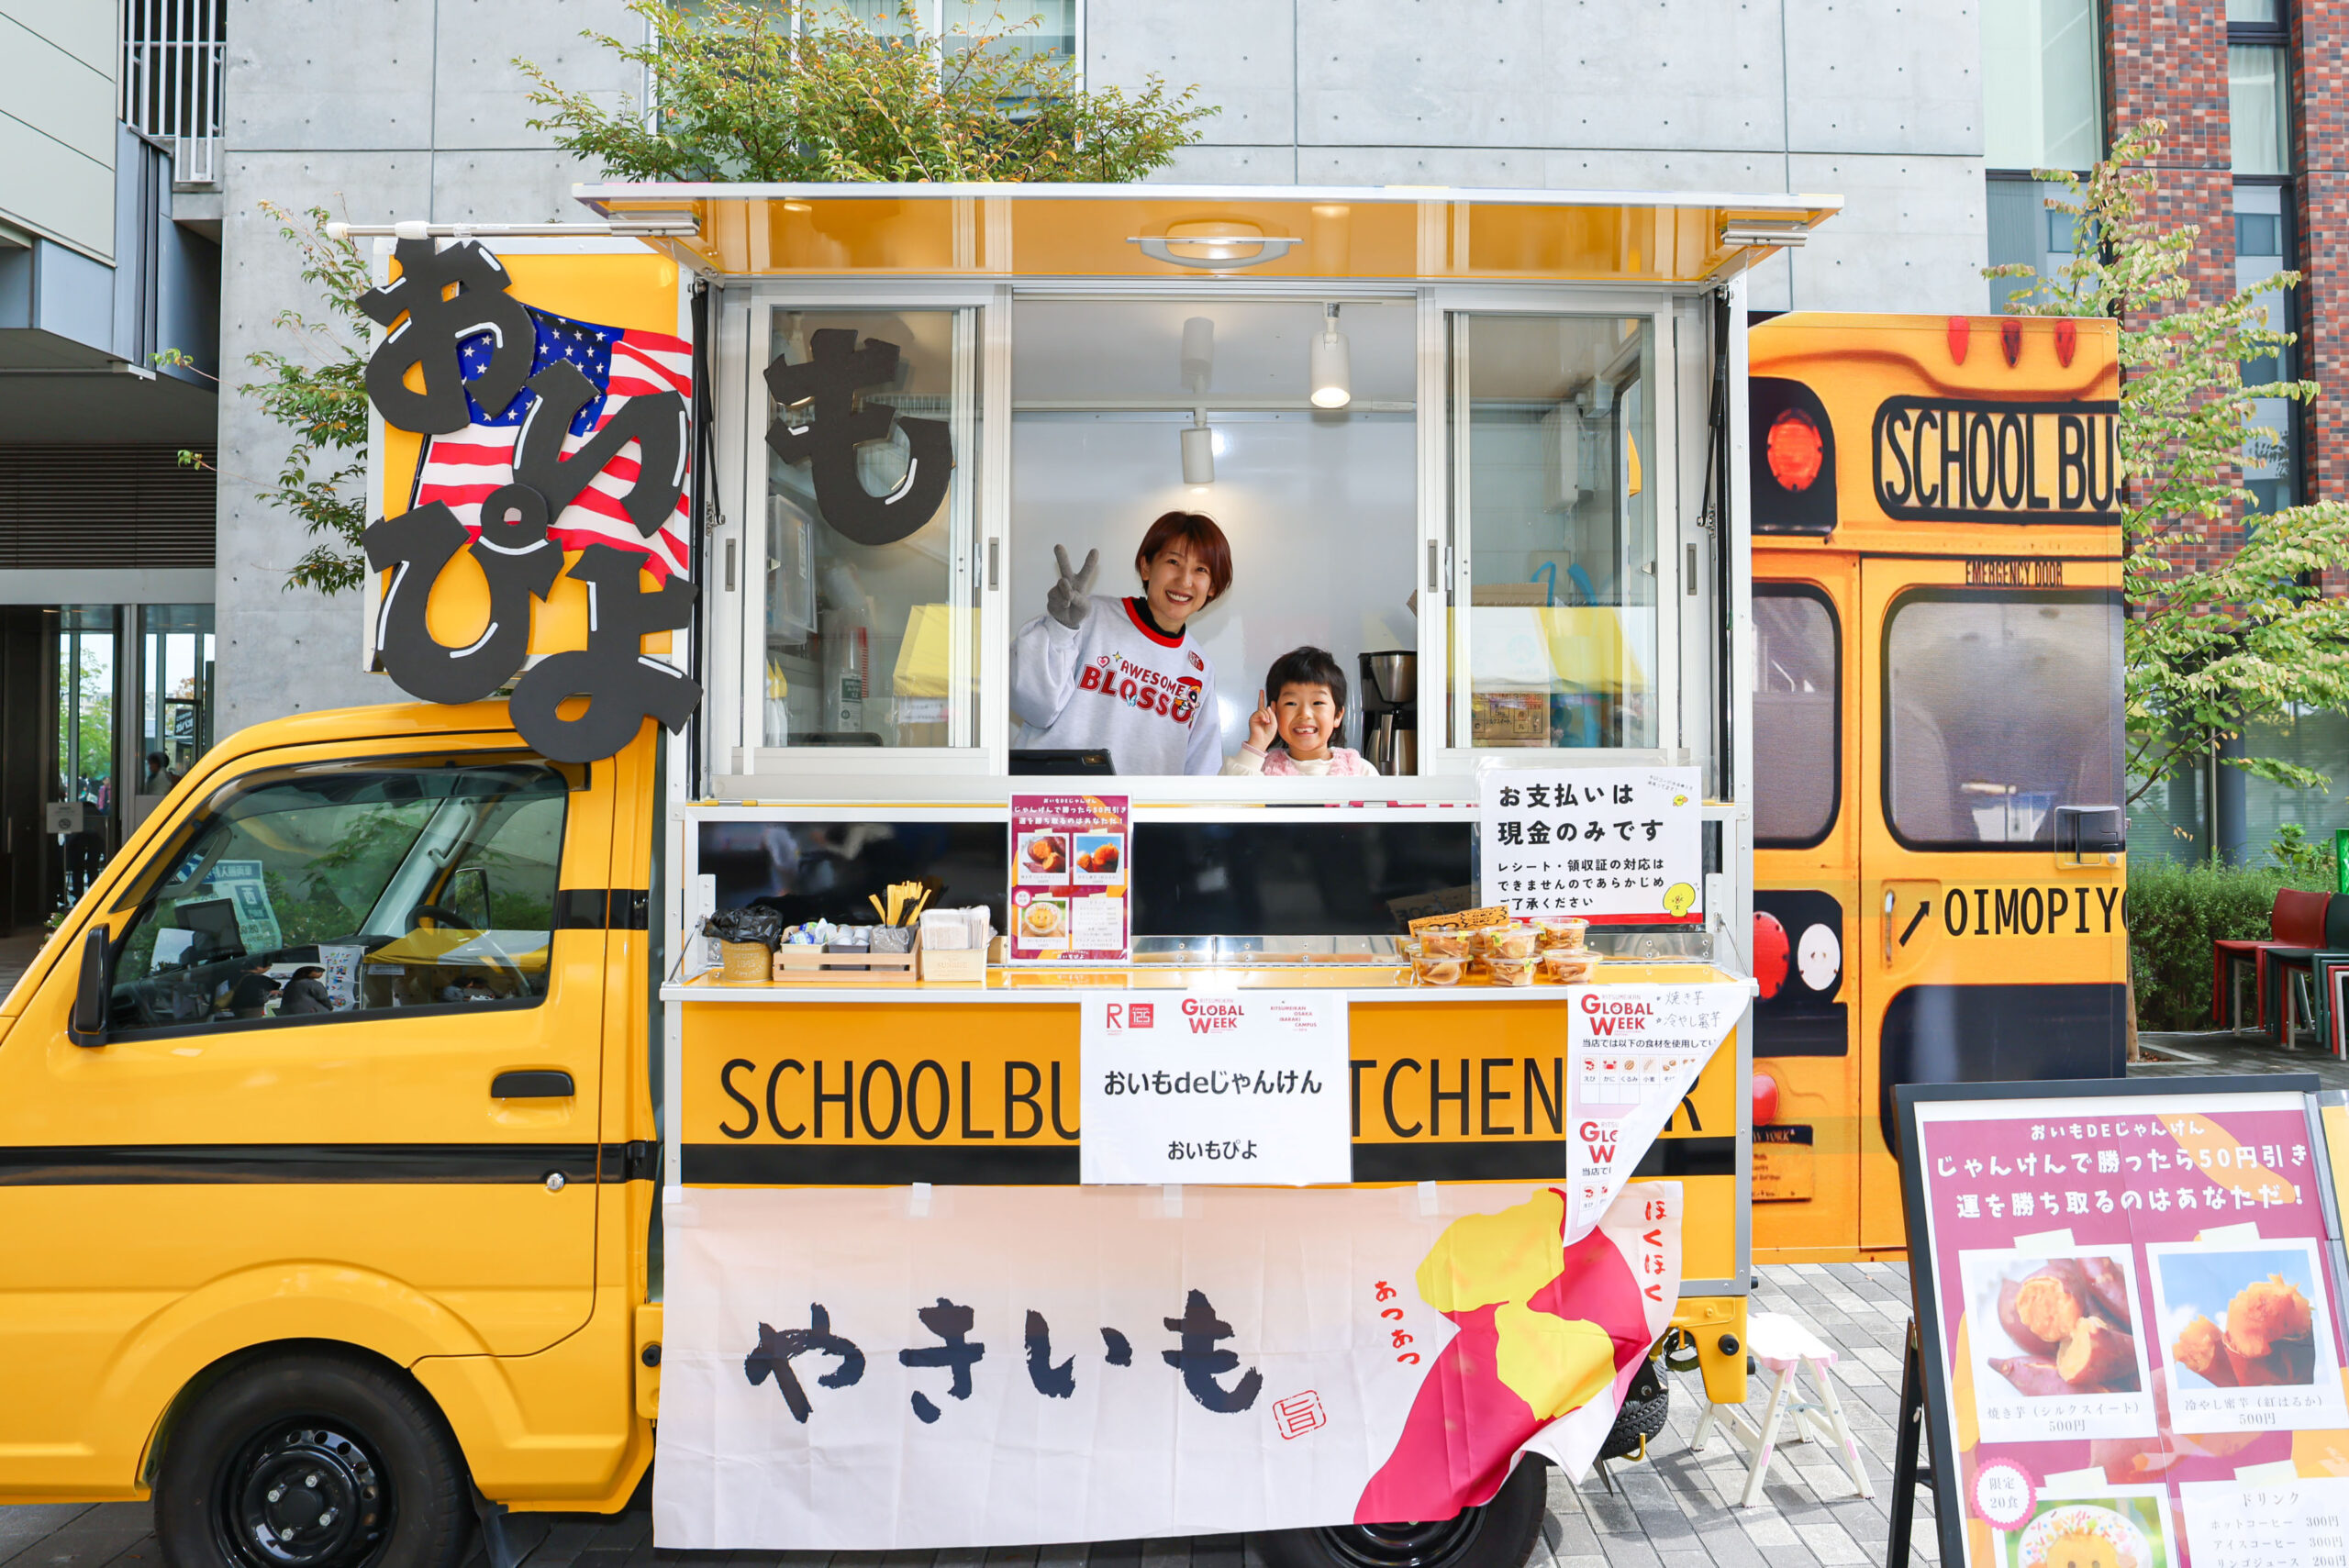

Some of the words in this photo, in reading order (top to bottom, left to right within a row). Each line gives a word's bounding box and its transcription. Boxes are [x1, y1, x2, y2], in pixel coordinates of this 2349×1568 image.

[1885, 409, 2049, 510] SCHOOL
[2058, 415, 2121, 512] BU
[1965, 561, 2031, 586] EMERGENCY
[2034, 561, 2063, 587] DOOR
[1119, 660, 1186, 696] AWESOME
[1499, 783, 1634, 808] お支払いは
[1497, 819, 1664, 846] 現金のみです
[1497, 859, 1664, 873] レシート・領収証の対応は
[1497, 876, 1664, 892] できませんのであらかじめ
[1944, 887, 2127, 937] OIMOPIY
[1182, 998, 1244, 1016] GLOBAL
[1581, 994, 1653, 1015] GLOBAL
[1189, 1018, 1238, 1034] WEEK
[1589, 1017, 1645, 1036] WEEK
[1104, 1070, 1322, 1095] おいもdeじゃんけん
[2031, 1120, 2205, 1140] おいもDEじゃんけん
[1168, 1140, 1258, 1161] おいもぴよ
[1937, 1144, 2308, 1178] じゃんけんで勝ったら50円引き
[1956, 1184, 2304, 1218] 運を勝ち取るのはあなただ！
[1642, 1200, 1667, 1302] ほくほく
[1375, 1280, 1420, 1365] あつあつ
[744, 1288, 1264, 1424] やきいも
[2048, 1419, 2086, 1432] 500円
[2239, 1412, 2276, 1425] 500円
[1989, 1477, 2015, 1490] 限定
[1989, 1496, 2019, 1509] 20食
[2243, 1492, 2299, 1507] ドリンク
[2211, 1518, 2294, 1529] ホットコーヒー
[2306, 1515, 2339, 1527] 300円
[2214, 1539, 2296, 1550] アイスコーヒー
[2310, 1535, 2343, 1548] 300円
[2313, 1554, 2347, 1567] 200円
